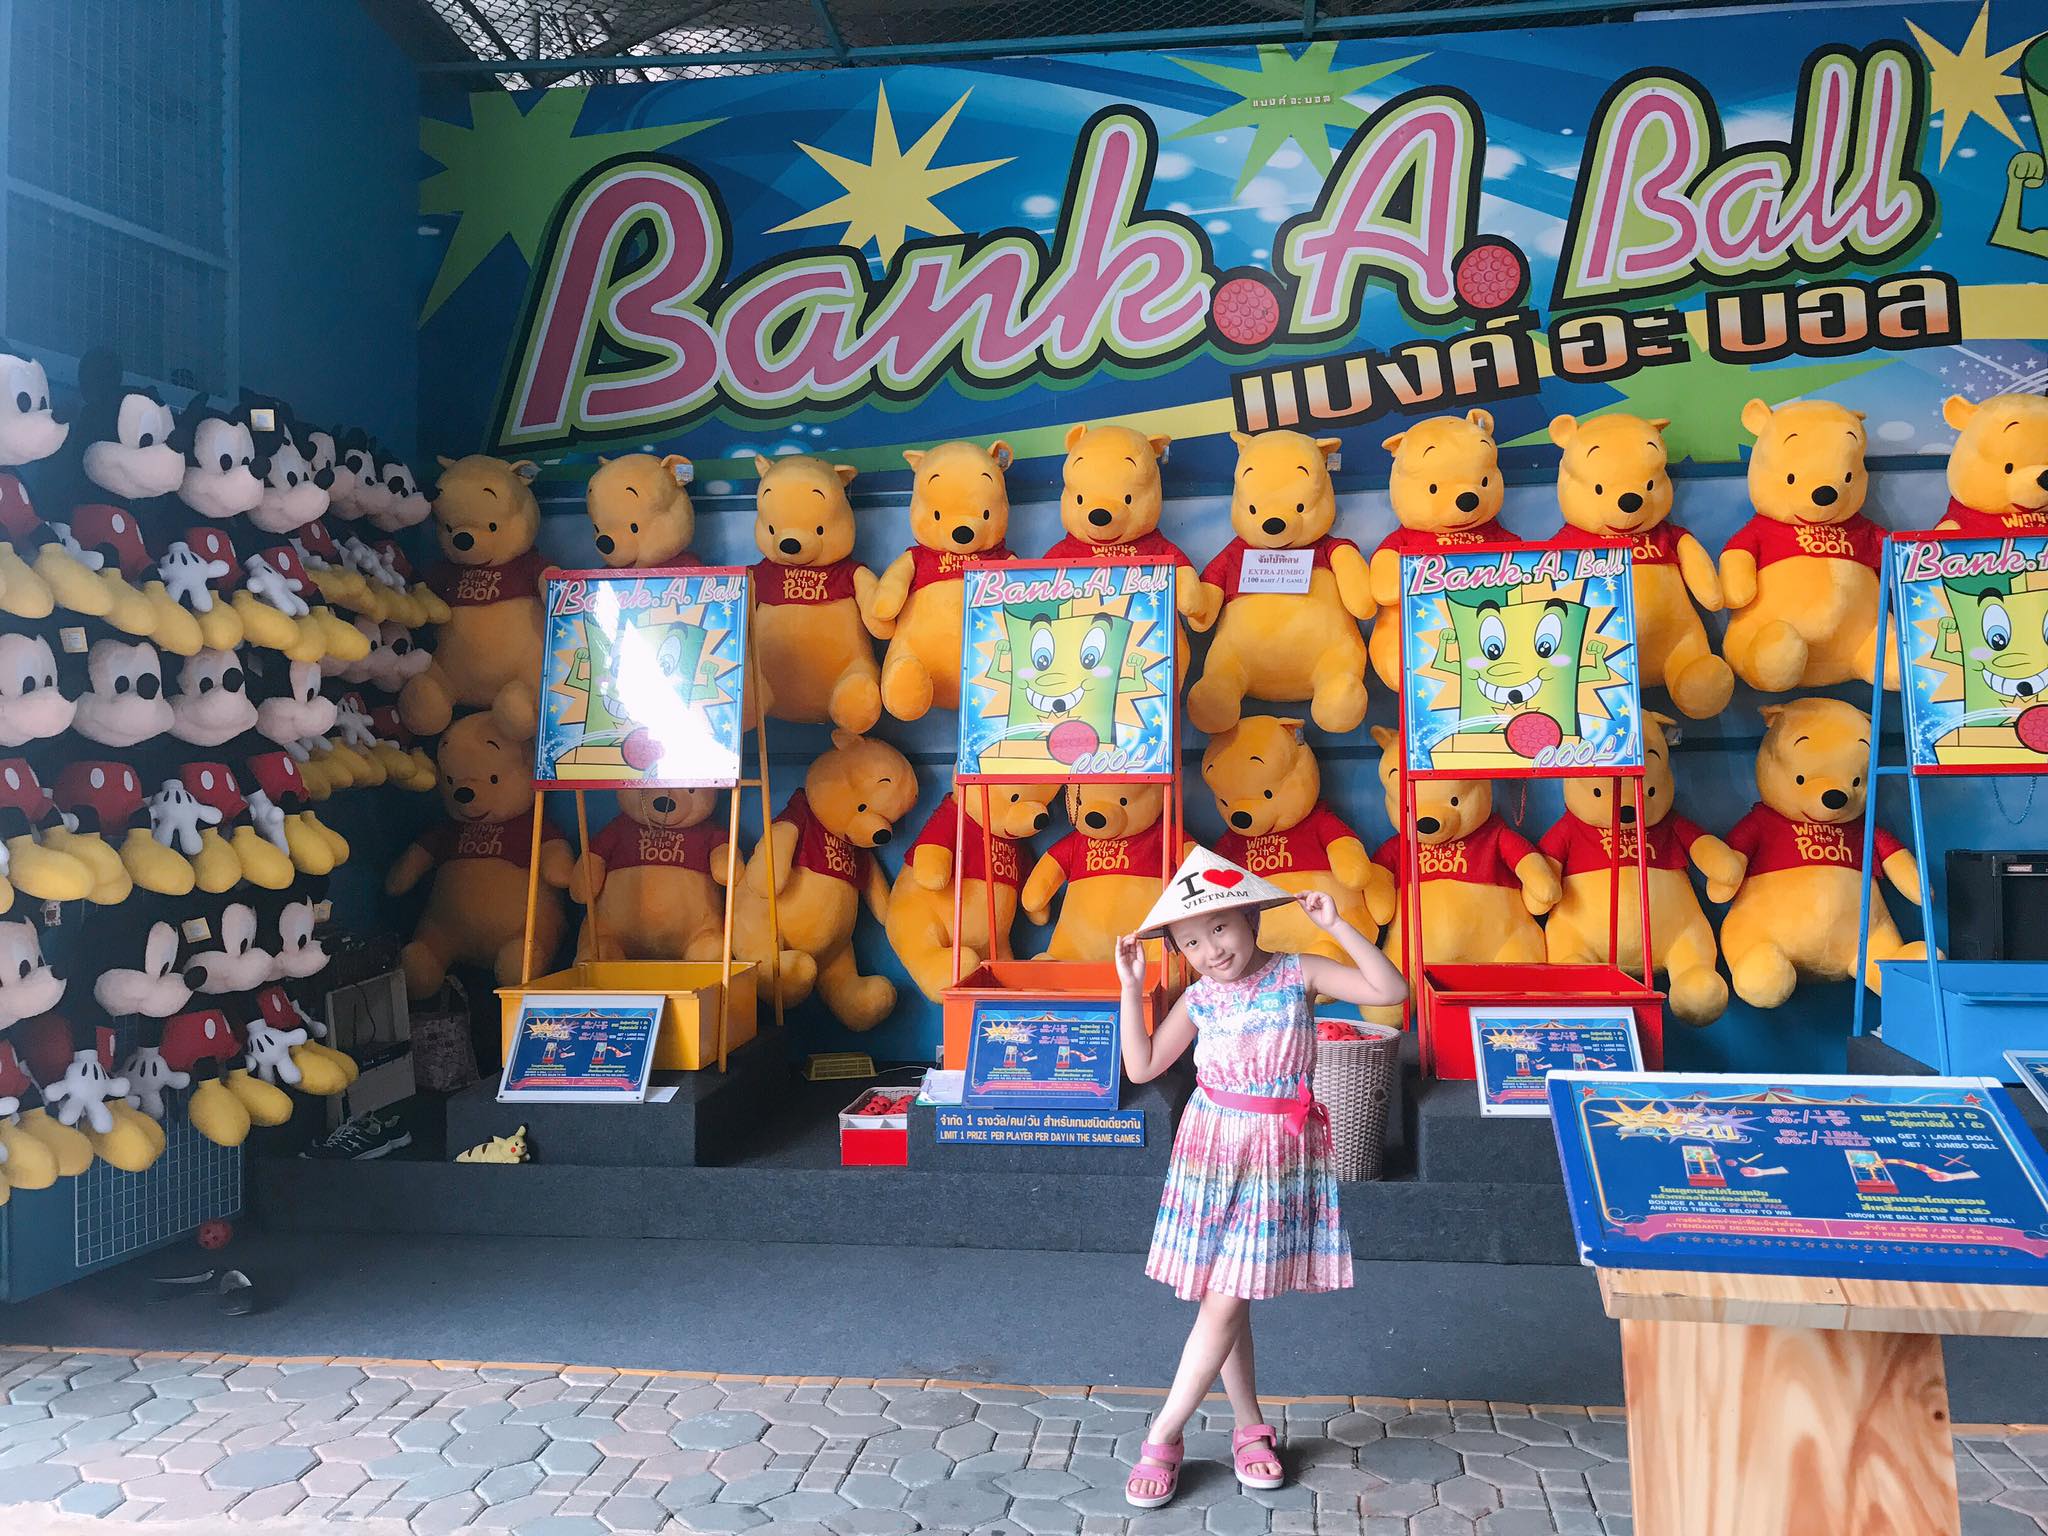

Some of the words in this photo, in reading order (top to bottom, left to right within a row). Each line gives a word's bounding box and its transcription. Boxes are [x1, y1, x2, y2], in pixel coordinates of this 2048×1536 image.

[1566, 54, 1917, 294] Ball
[1557, 313, 1678, 375] อะ
[1717, 275, 1952, 354] บอล
[2001, 513, 2048, 529] Winni
[1793, 524, 1848, 535] Winnie
[1814, 531, 1836, 542] the
[1091, 545, 1138, 555] Winnie
[1632, 534, 1663, 560] oh
[1795, 533, 1854, 556] Pooh
[938, 552, 980, 567] Winnie
[1574, 548, 1626, 580] Ball
[784, 568, 828, 581] Winnie
[1248, 568, 1275, 576] EXTRA
[1276, 568, 1305, 576] JUMBO
[797, 577, 815, 588] the
[1120, 565, 1169, 595] Ball
[783, 578, 828, 600] Pooh
[639, 828, 685, 842] Winnie
[1791, 822, 1845, 837] Winnie
[1087, 838, 1129, 850] Winnie
[1246, 834, 1289, 850] Winnie
[1814, 834, 1833, 844] the
[637, 838, 685, 863] Pooh
[1098, 846, 1115, 858] the
[1258, 844, 1276, 856] the
[1433, 848, 1453, 860] the
[1794, 836, 1853, 863] Pooh
[1086, 847, 1130, 871] Pooh
[1245, 843, 1293, 872] Pooh
[1417, 849, 1468, 874] Pooh
[1177, 871, 1206, 902] I
[1183, 890, 1249, 910] VIETNAM
[940, 1113, 963, 1126] จำกัด
[966, 1114, 973, 1126] 1
[940, 1130, 958, 1140] LIMIT
[960, 1131, 964, 1140] 1
[967, 1131, 987, 1140] PRIZE
[990, 1131, 1005, 1140] PER
[1006, 1131, 1033, 1141] PLAYER
[1035, 1132, 1049, 1141] PER
[1076, 1133, 1090, 1142] THE
[1092, 1133, 1113, 1143] SAME
[1114, 1134, 1141, 1143] GAMES
[1872, 1136, 1897, 1144] WIN
